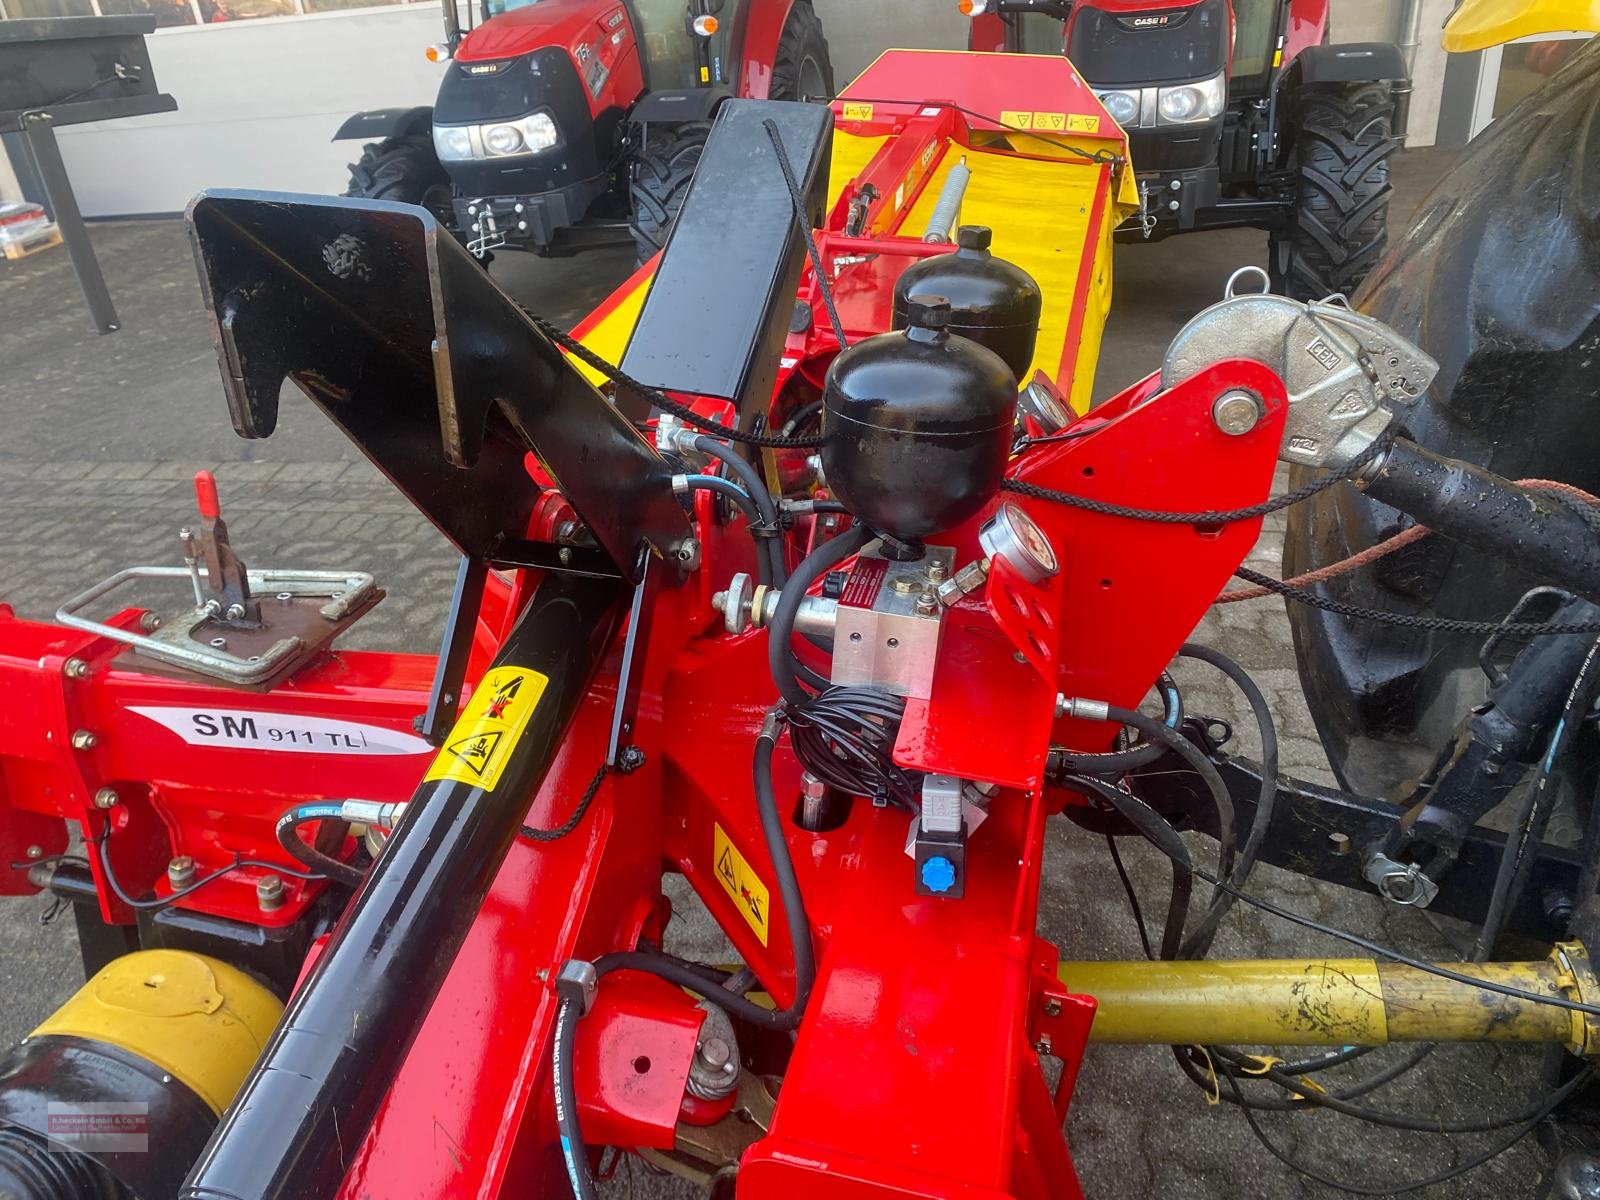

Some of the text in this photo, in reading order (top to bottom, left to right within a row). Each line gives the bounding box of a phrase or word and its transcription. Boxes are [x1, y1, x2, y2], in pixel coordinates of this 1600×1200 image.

[192, 714, 258, 740] SM
[268, 728, 314, 745] 911
[556, 1106, 564, 1121] EN
